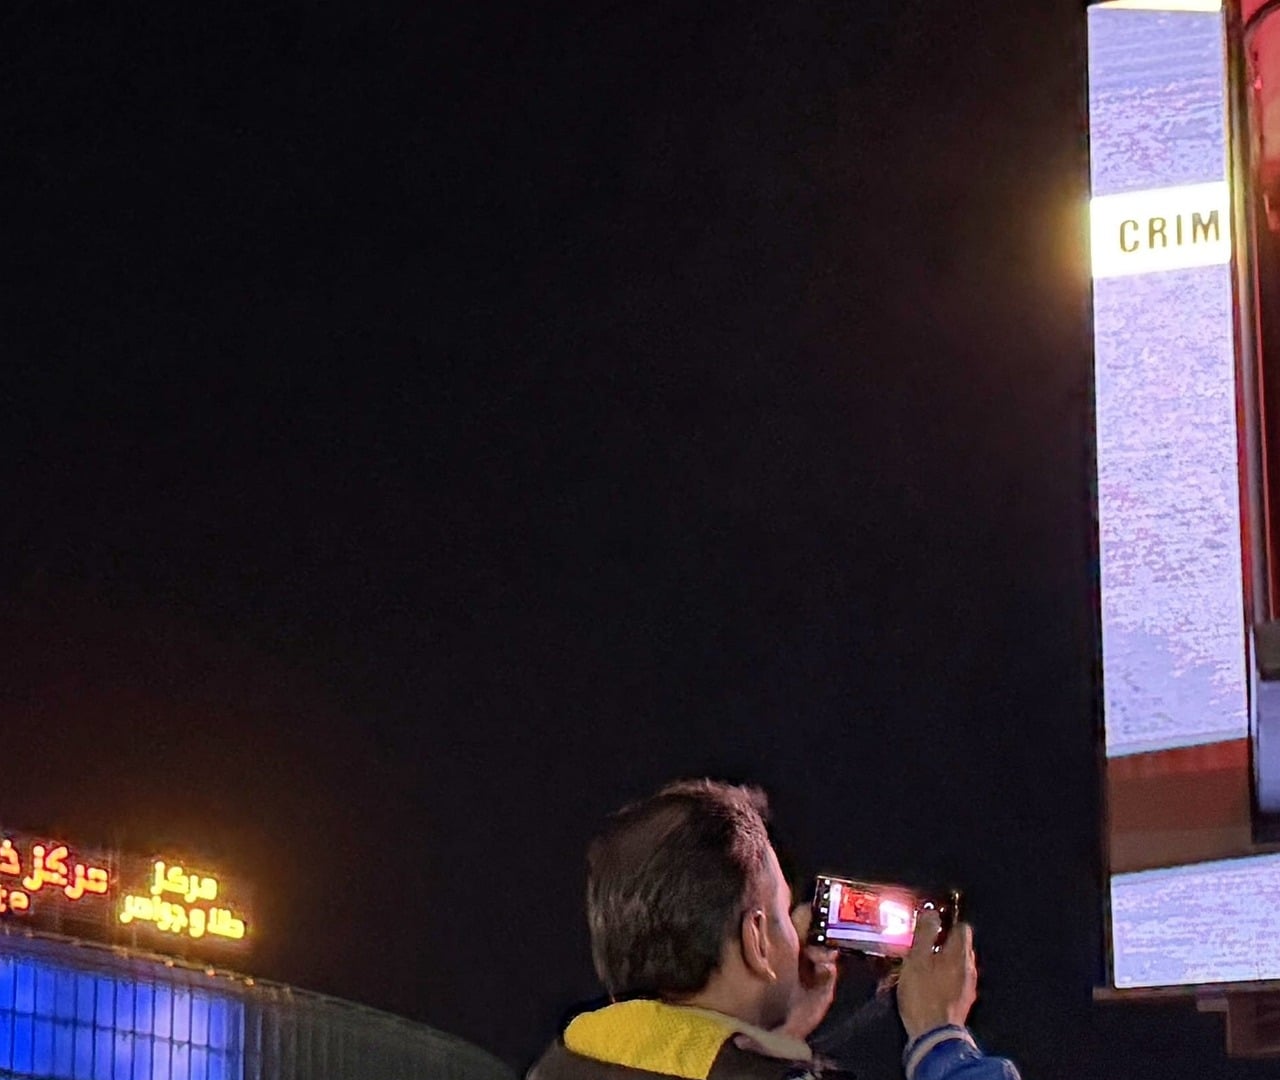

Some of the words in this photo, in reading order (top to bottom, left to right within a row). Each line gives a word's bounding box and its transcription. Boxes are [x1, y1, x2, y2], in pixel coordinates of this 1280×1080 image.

[1120, 210, 1219, 253] CRIM
[22, 844, 109, 900] مرکز
[150, 860, 218, 903] مرکز
[119, 894, 188, 933] جواهر
[188, 908, 206, 938] و
[207, 906, 245, 940] طلا
